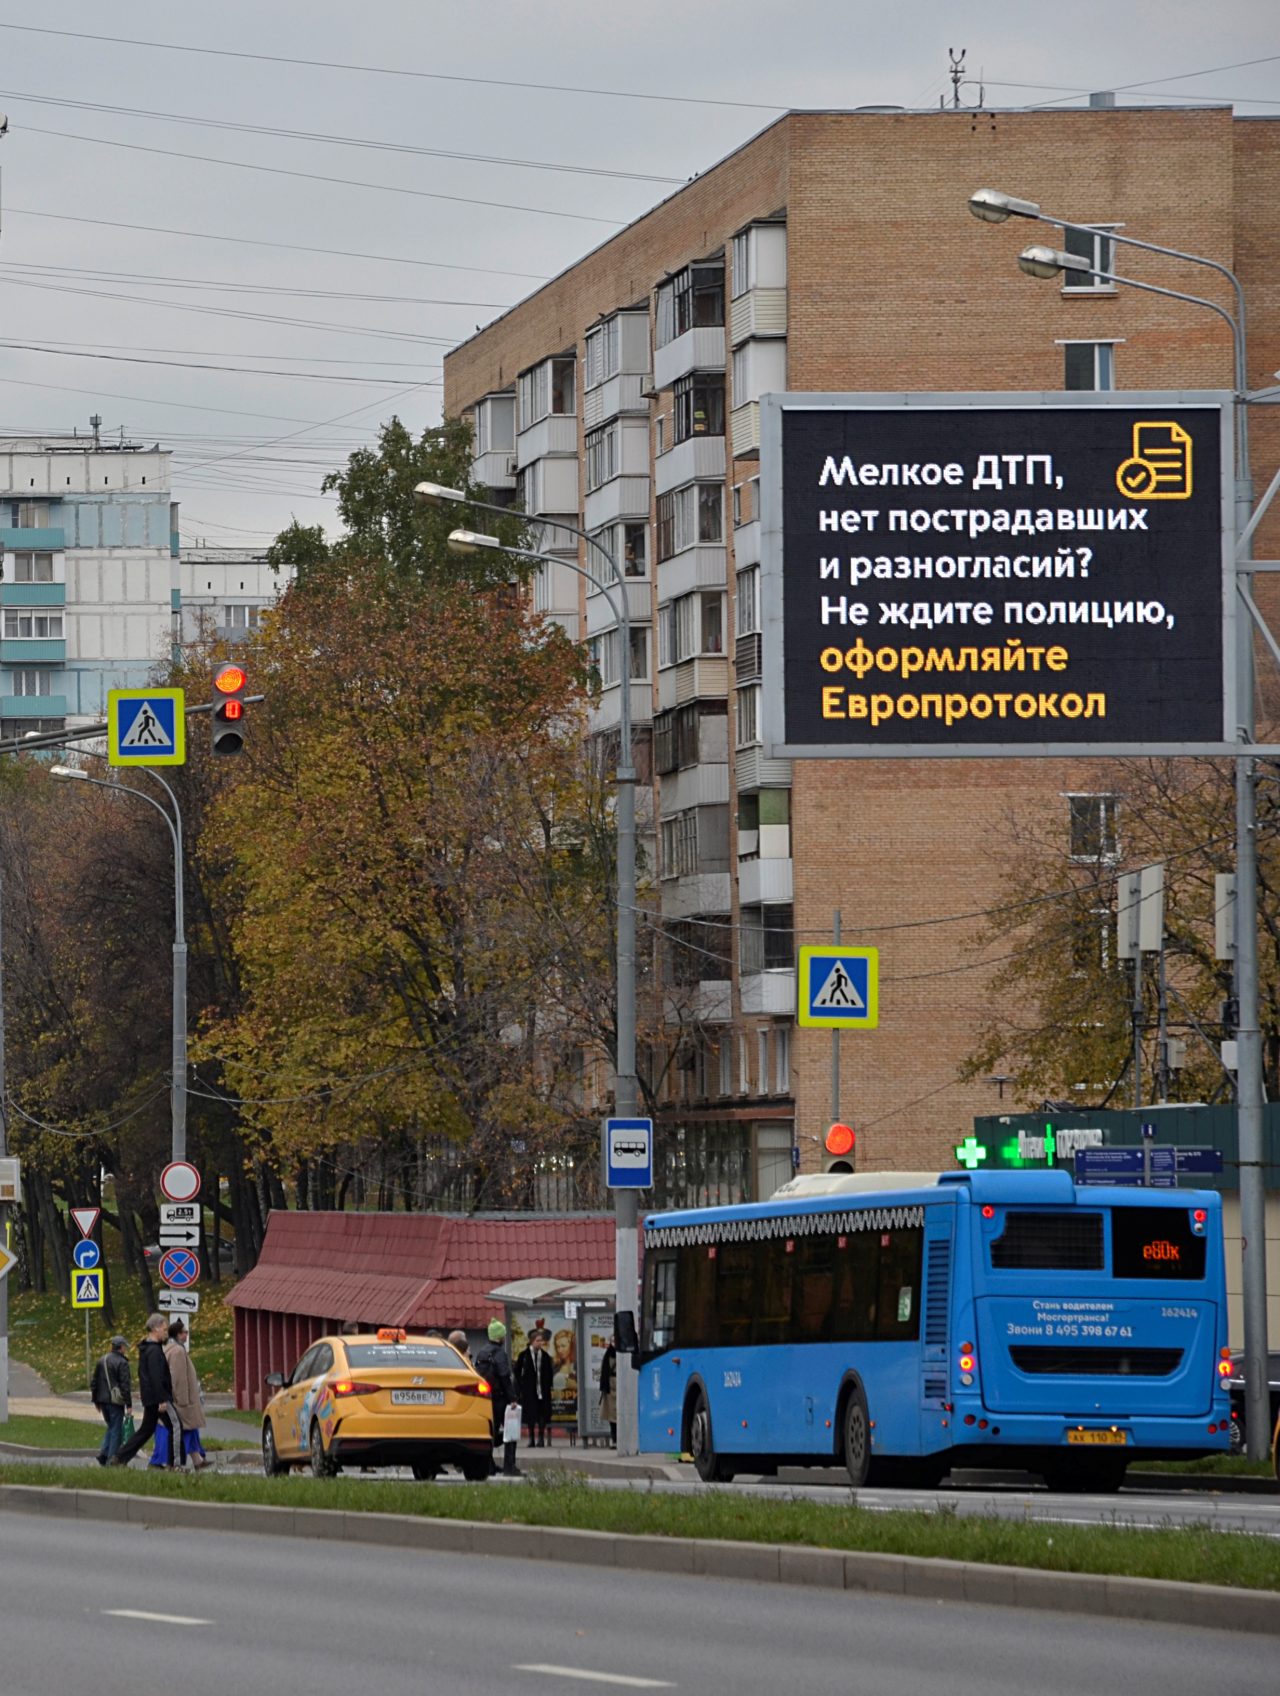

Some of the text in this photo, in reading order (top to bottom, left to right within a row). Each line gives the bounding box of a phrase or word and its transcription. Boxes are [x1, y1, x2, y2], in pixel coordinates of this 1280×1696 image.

[819, 455, 1063, 490] Мелкое ДТП,
[820, 507, 1148, 539] нет пострадавших
[820, 548, 1092, 585] и разногласий?
[821, 596, 1175, 629] Не ждите полицию,
[821, 638, 1069, 679] оформляйте
[822, 686, 1106, 726] Европротокол
[1032, 1300, 1114, 1311] Стань водителем
[1037, 1312, 1110, 1323] Мосгортранса!
[1006, 1323, 1133, 1338] Звони 8 495 398 67 61
